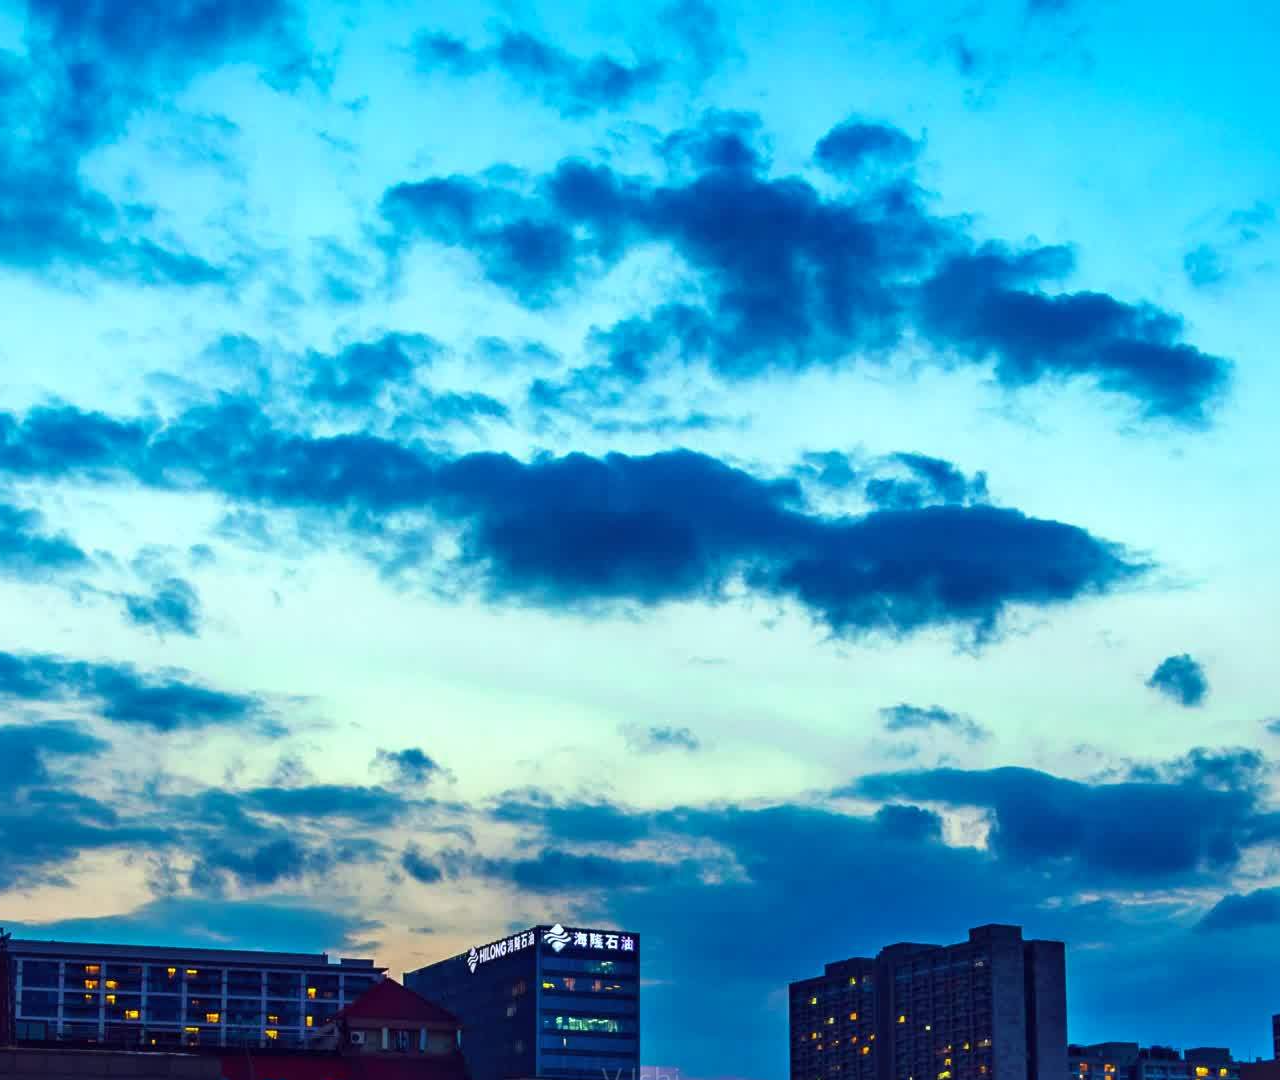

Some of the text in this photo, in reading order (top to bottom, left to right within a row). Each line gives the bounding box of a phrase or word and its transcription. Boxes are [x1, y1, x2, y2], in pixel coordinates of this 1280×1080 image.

[479, 932, 535, 964] HILONG 海隆石油
[573, 931, 634, 951] 海隆石油
